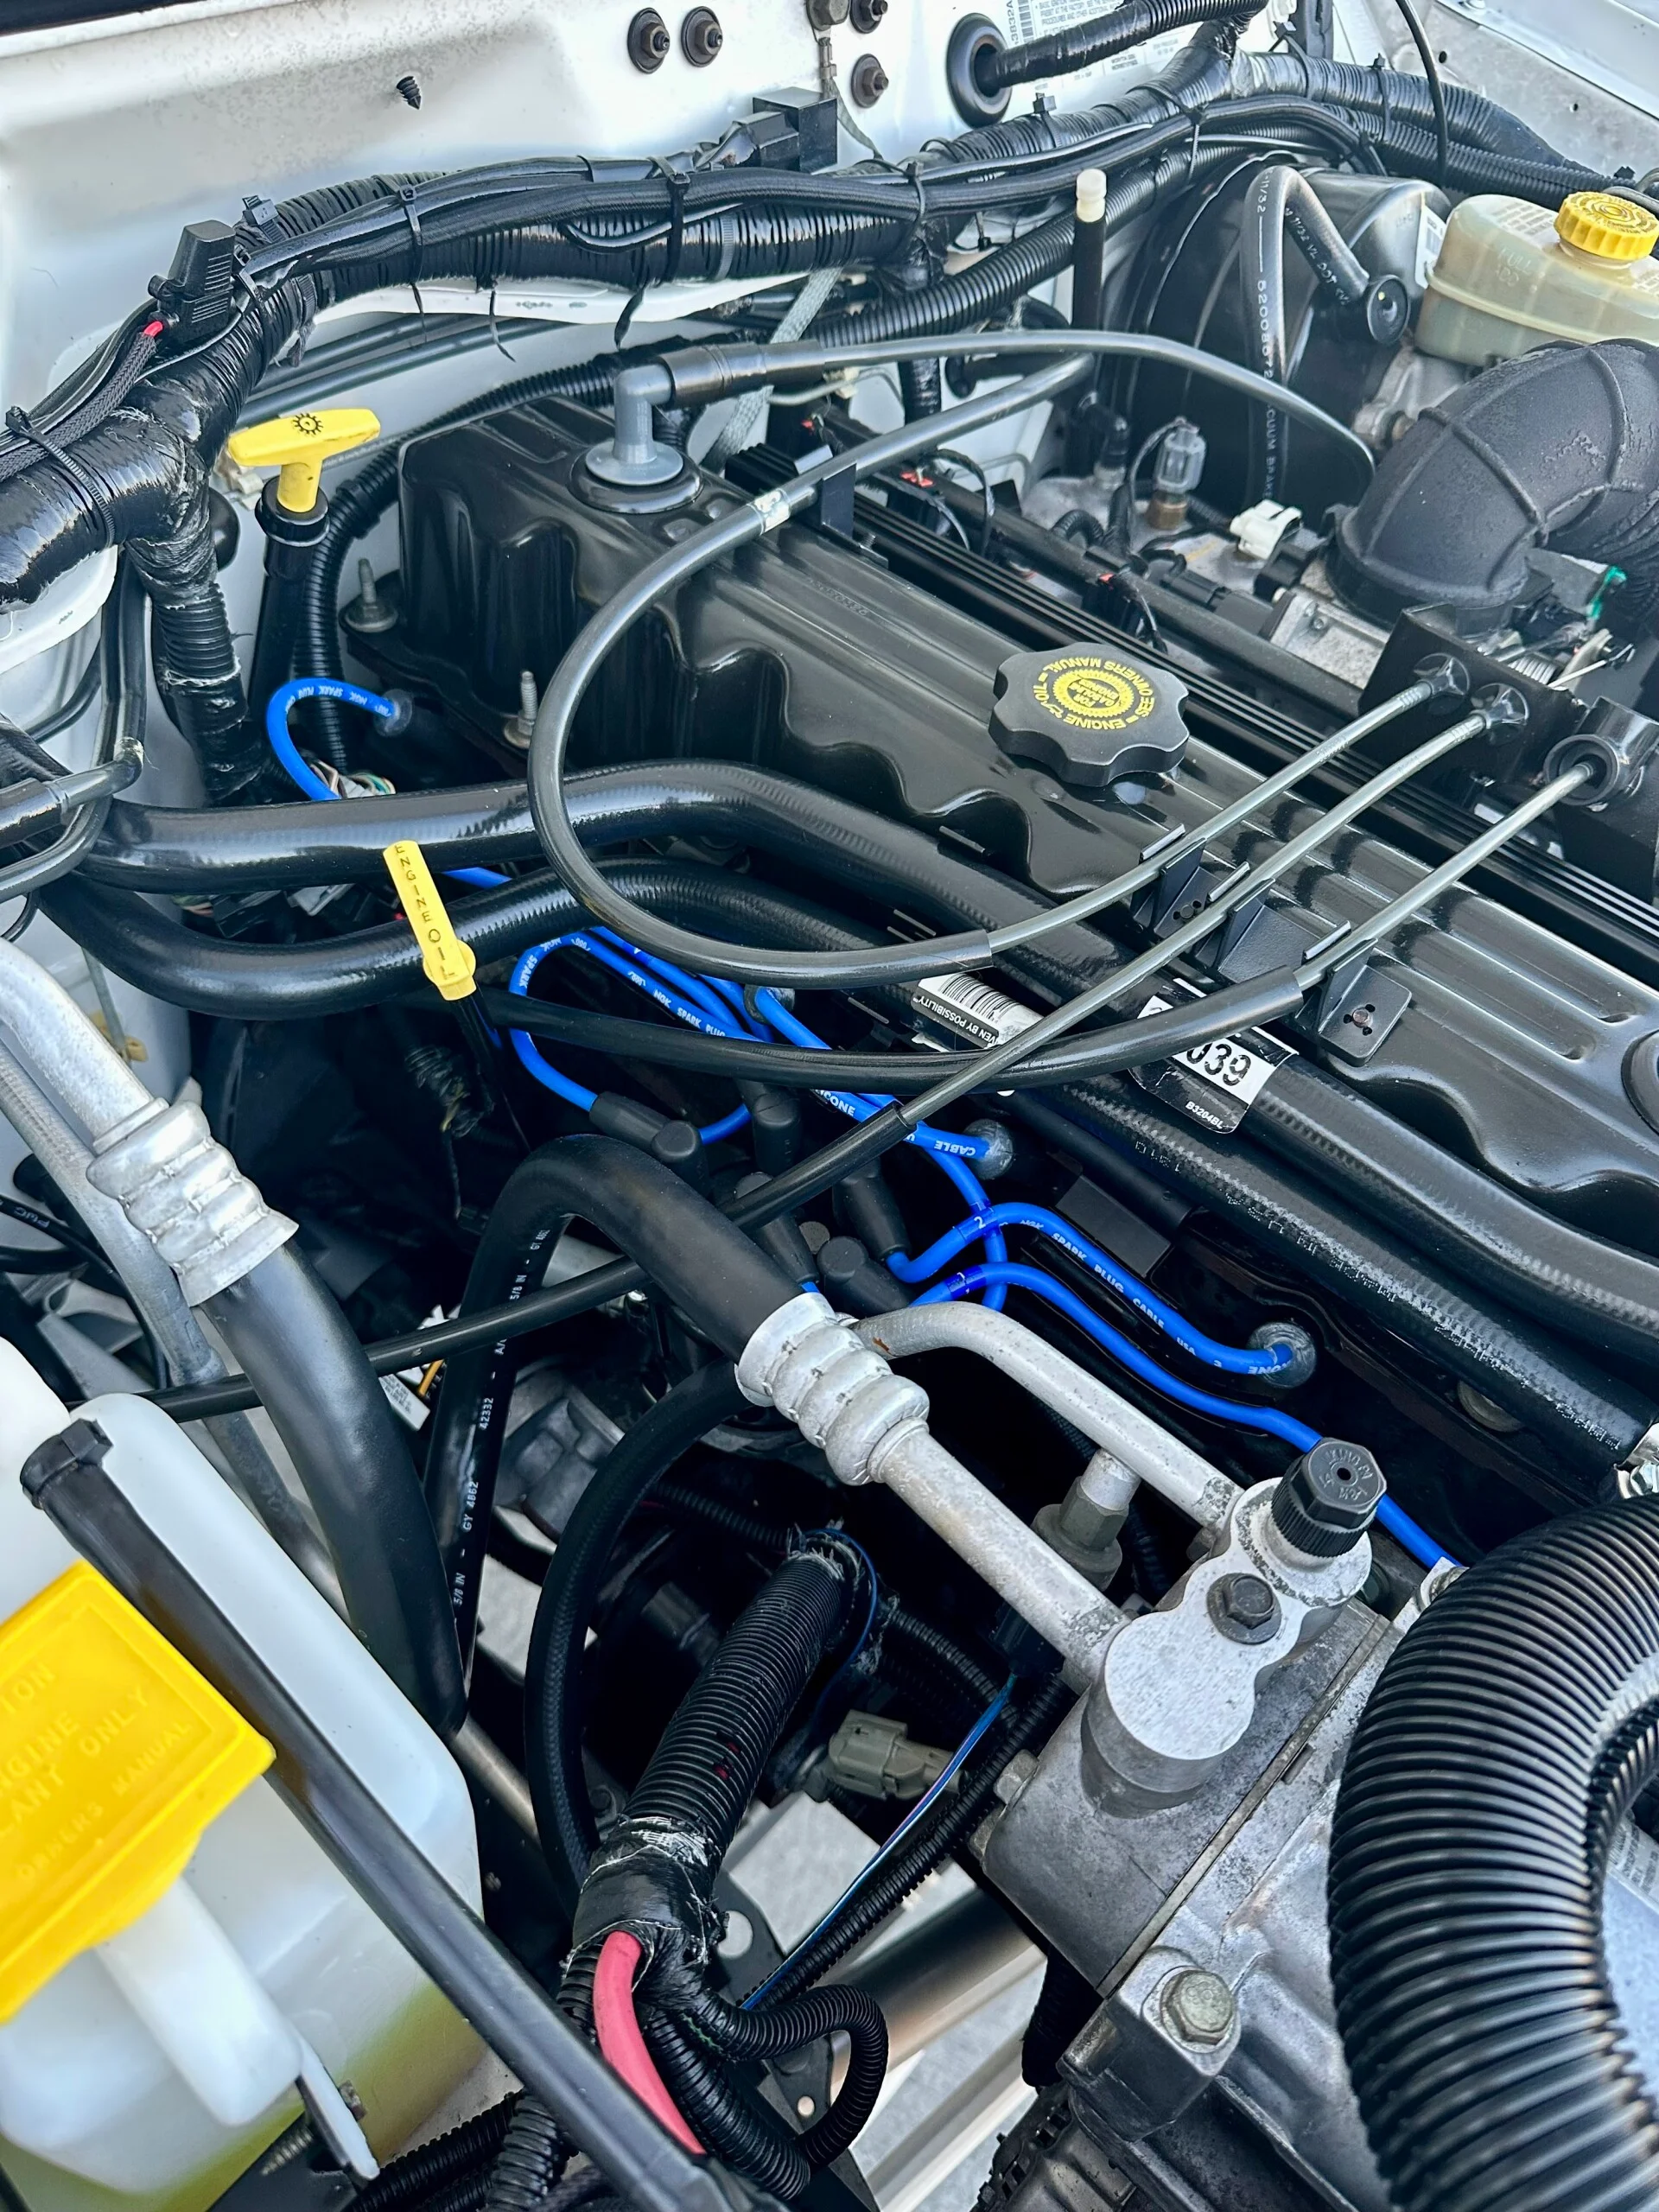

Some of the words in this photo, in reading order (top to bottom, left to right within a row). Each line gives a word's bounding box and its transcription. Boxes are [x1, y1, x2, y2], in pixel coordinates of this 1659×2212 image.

[1042, 657, 1102, 673] MANUAL
[1103, 660, 1154, 696] OWNERS
[318, 685, 344, 698] SPARK
[1033, 683, 1050, 702] OIL
[1067, 683, 1116, 707] GASOLINE
[1072, 694, 1096, 708] FOR
[1135, 696, 1156, 718] SEE
[1063, 713, 1127, 730] ENGINE
[394, 844, 432, 923] ENGINE
[428, 928, 457, 981] OIL
[540, 938, 563, 952] NGK
[518, 955, 538, 989] SPARK
[652, 988, 671, 1008] NGK
[677, 1007, 702, 1029] SPARK
[965, 1022, 980, 1034] BY
[1185, 1039, 1252, 1087] 039
[934, 1140, 976, 1156] CABLE
[974, 1216, 987, 1230] 2
[515, 1274, 527, 1283] IN
[1051, 1232, 1087, 1261] SPARK
[1094, 1263, 1124, 1294] PLUG
[1133, 1298, 1165, 1328] CABLE
[510, 1286, 523, 1300] 5/8
[479, 1397, 493, 1429] 42332
[462, 1514, 474, 1532] GY
[455, 1573, 466, 1586] IN
[454, 1586, 463, 1606] 5/8
[78, 1683, 149, 1758] ONLY
[111, 1722, 192, 1797] MANUAL
